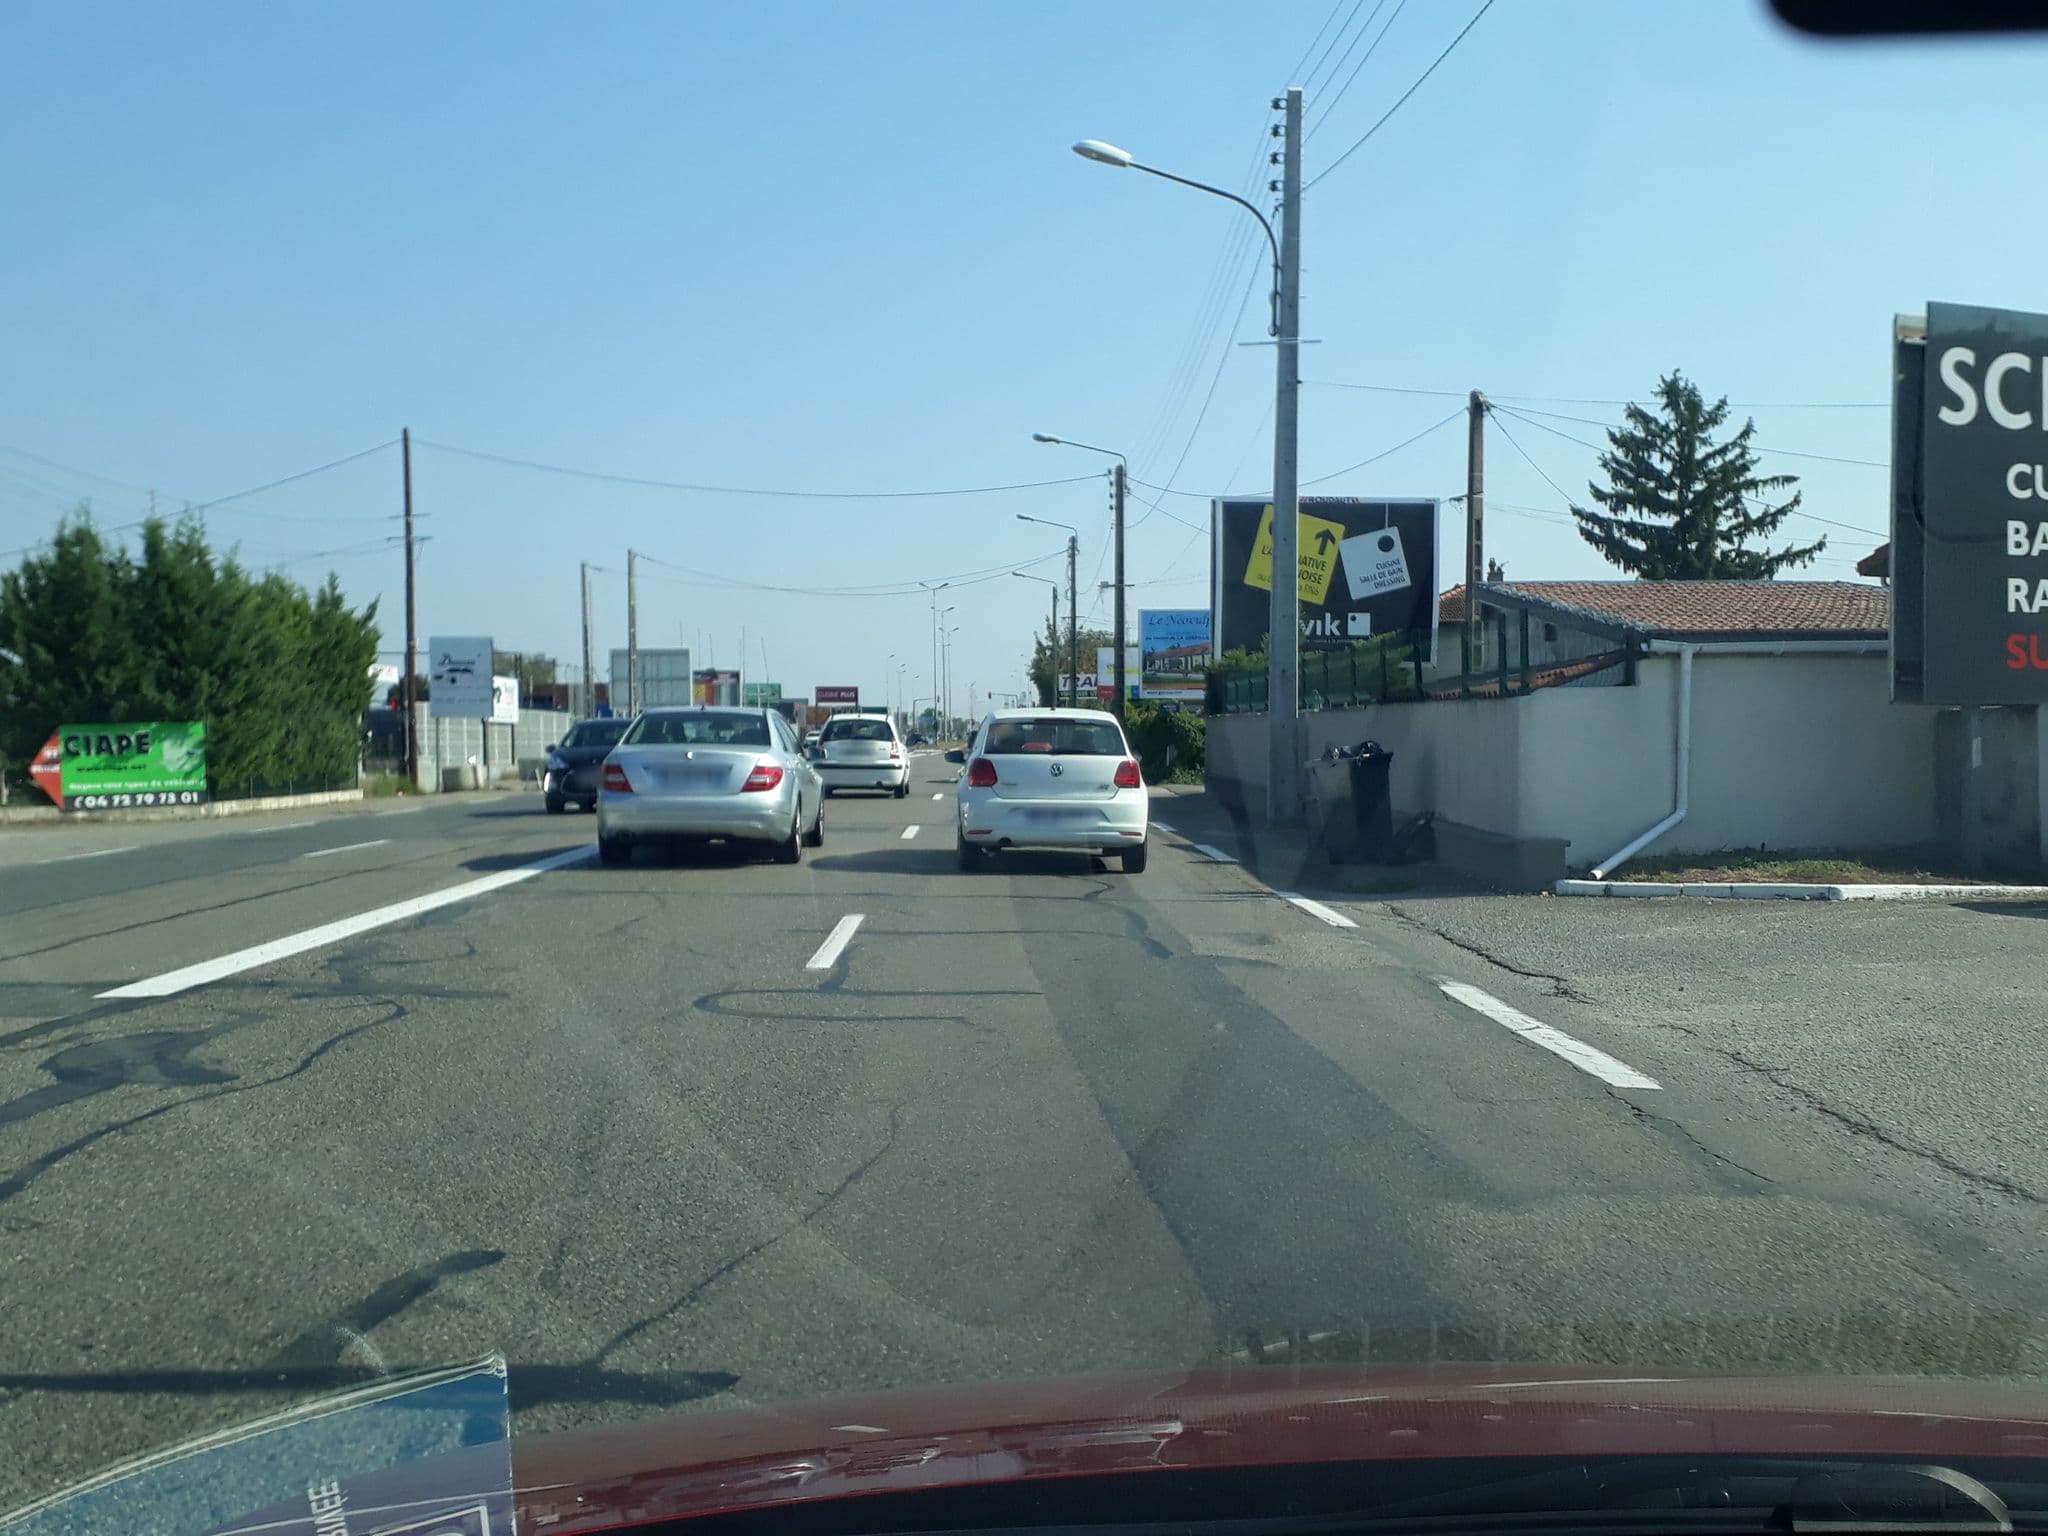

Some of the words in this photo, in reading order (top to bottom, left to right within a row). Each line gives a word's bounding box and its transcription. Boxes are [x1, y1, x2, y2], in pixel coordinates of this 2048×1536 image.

[1938, 346, 2048, 432] SC
[64, 733, 150, 757] CIAPE
[112, 794, 131, 807] 72
[180, 791, 199, 804] 01
